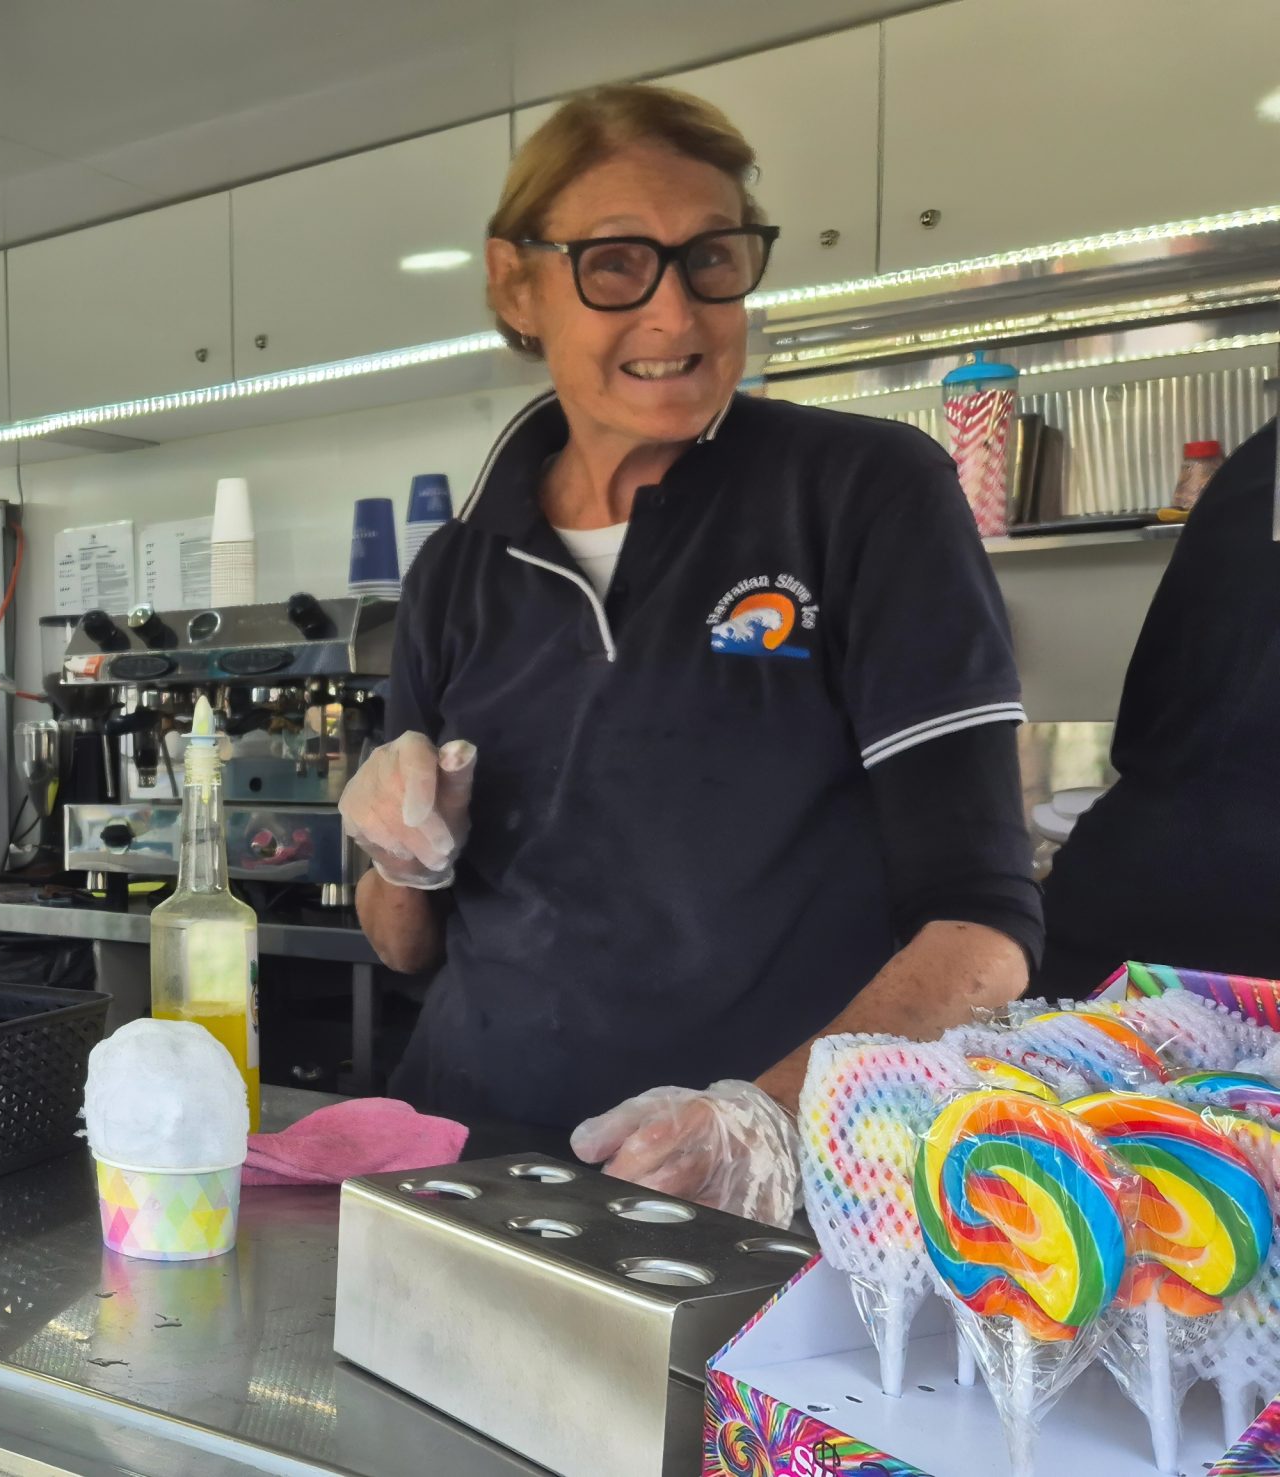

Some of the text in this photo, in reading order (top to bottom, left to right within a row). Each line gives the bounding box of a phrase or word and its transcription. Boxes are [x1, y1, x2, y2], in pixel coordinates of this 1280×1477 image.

[705, 574, 819, 629] Hawaiian Shave Ice
